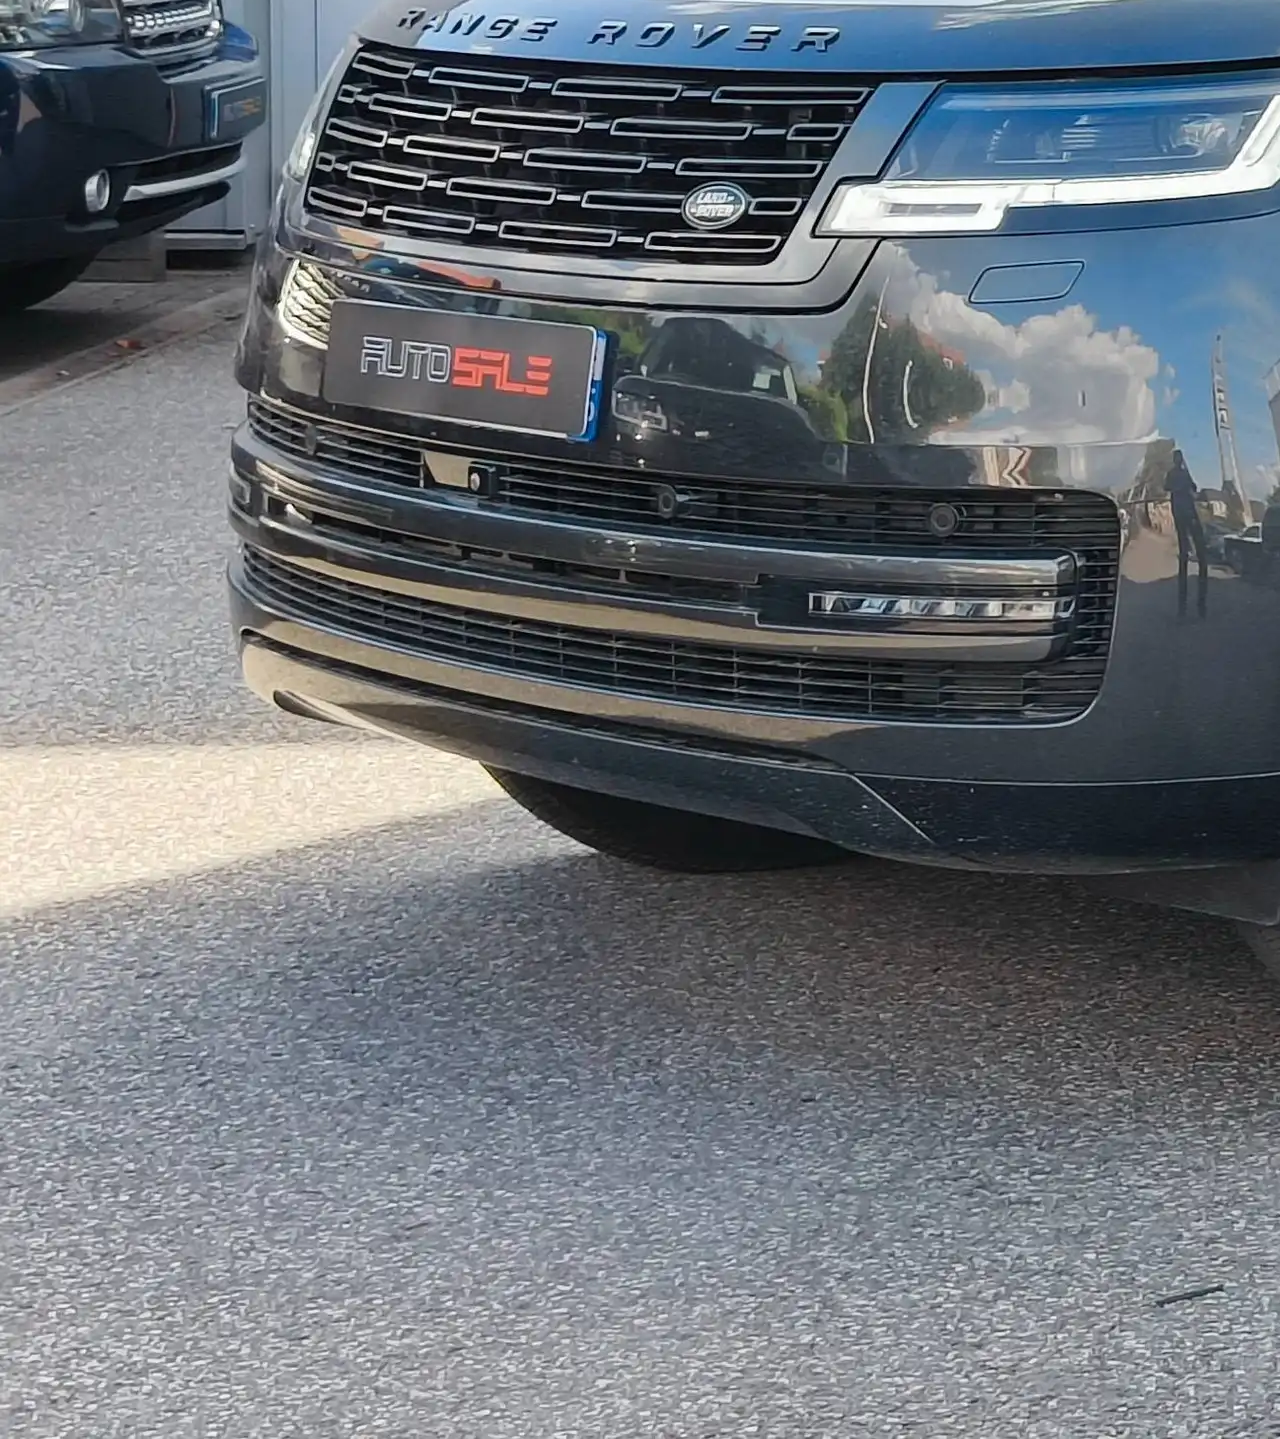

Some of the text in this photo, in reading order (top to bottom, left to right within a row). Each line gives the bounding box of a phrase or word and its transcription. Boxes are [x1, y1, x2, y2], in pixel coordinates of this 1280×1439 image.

[397, 7, 840, 53] RANGE ROVER
[361, 336, 553, 396] AUTOSALE
